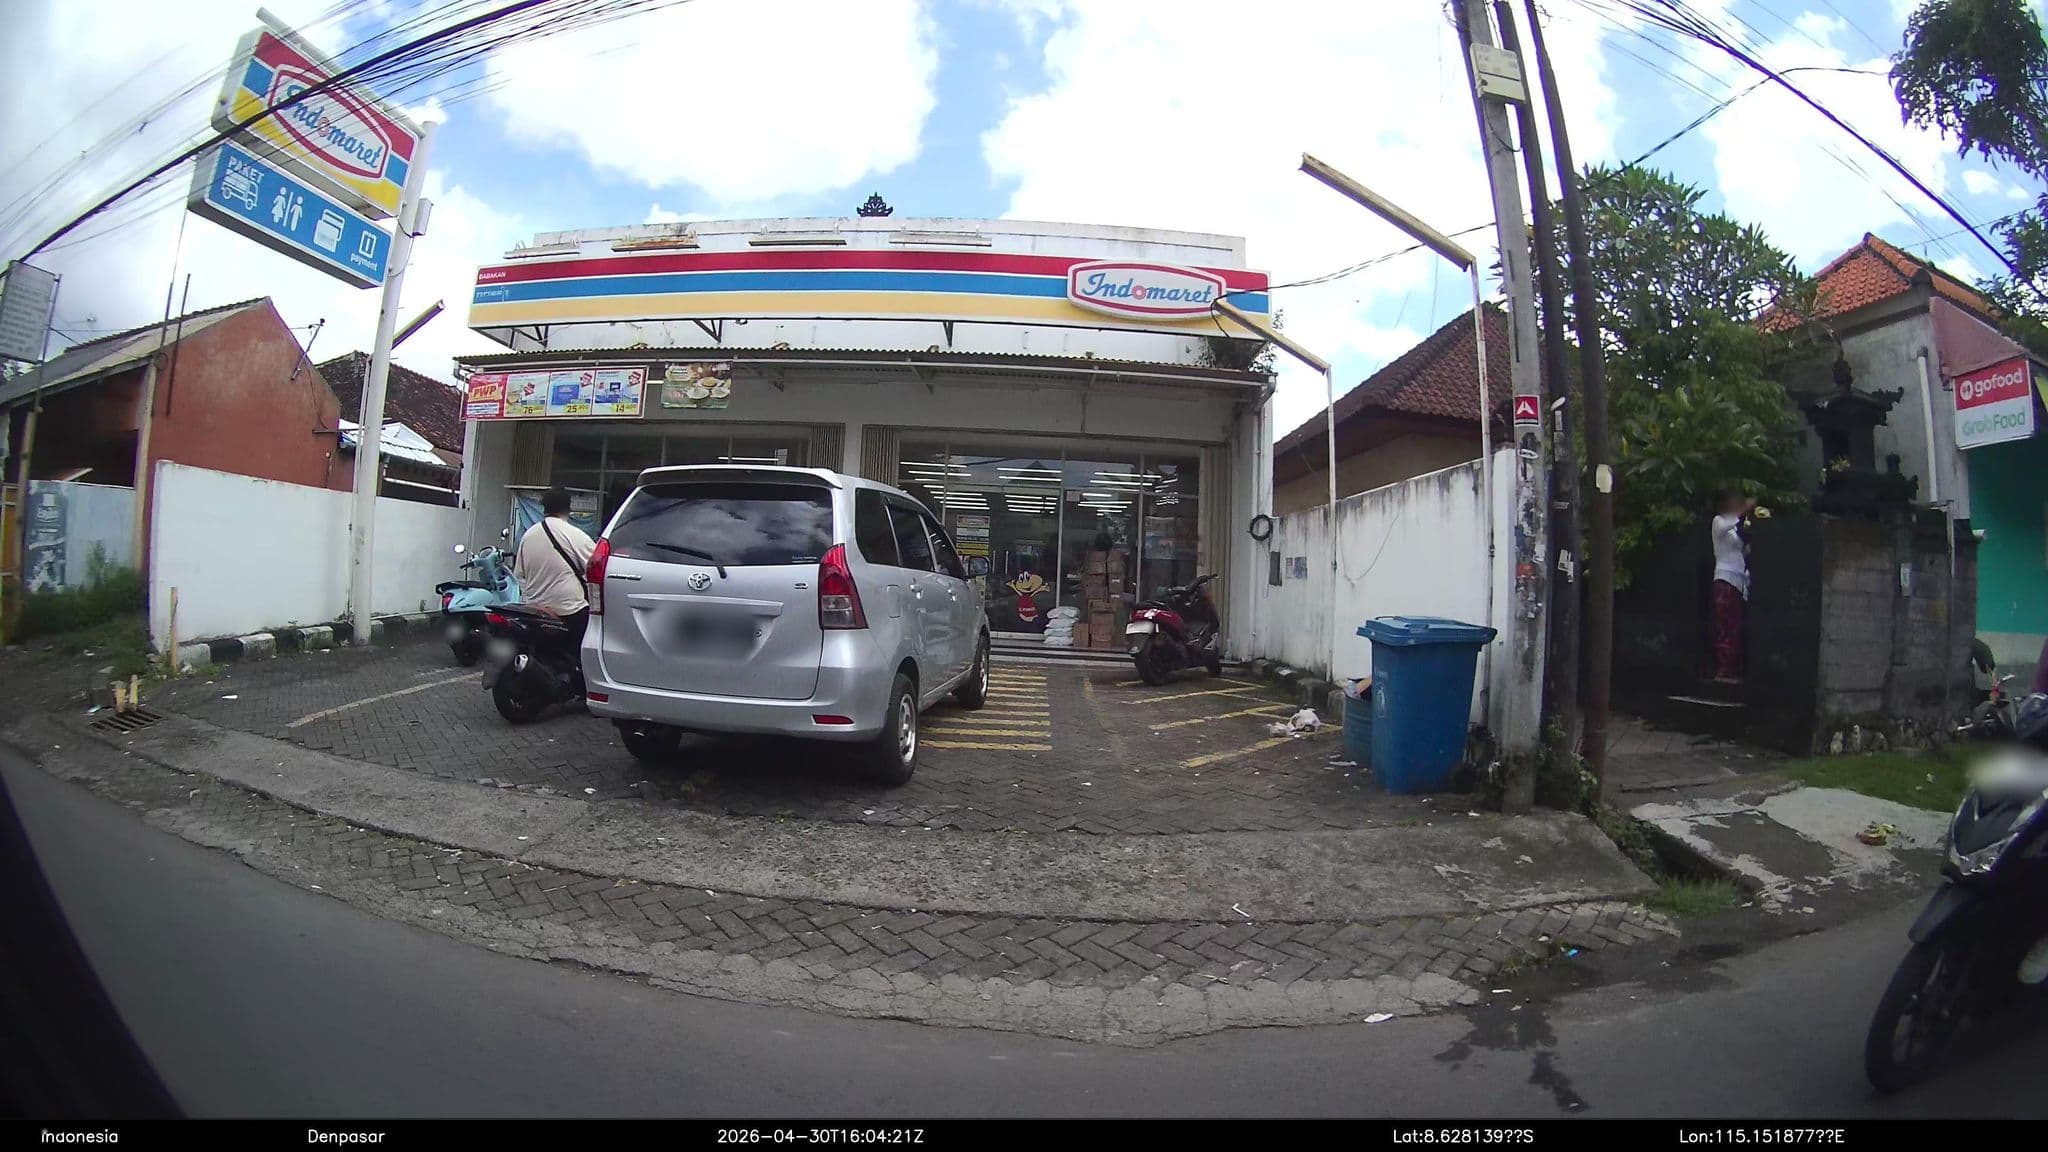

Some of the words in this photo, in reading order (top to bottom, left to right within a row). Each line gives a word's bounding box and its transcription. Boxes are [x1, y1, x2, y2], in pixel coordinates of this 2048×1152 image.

[228, 156, 264, 183] PAKET
[350, 253, 378, 272] payment
[479, 272, 506, 280] BABAKAN
[1082, 273, 1213, 303] Indomaret
[473, 386, 497, 397] PWP
[1975, 369, 2022, 396] gofood
[1963, 410, 2025, 435] GrabFood
